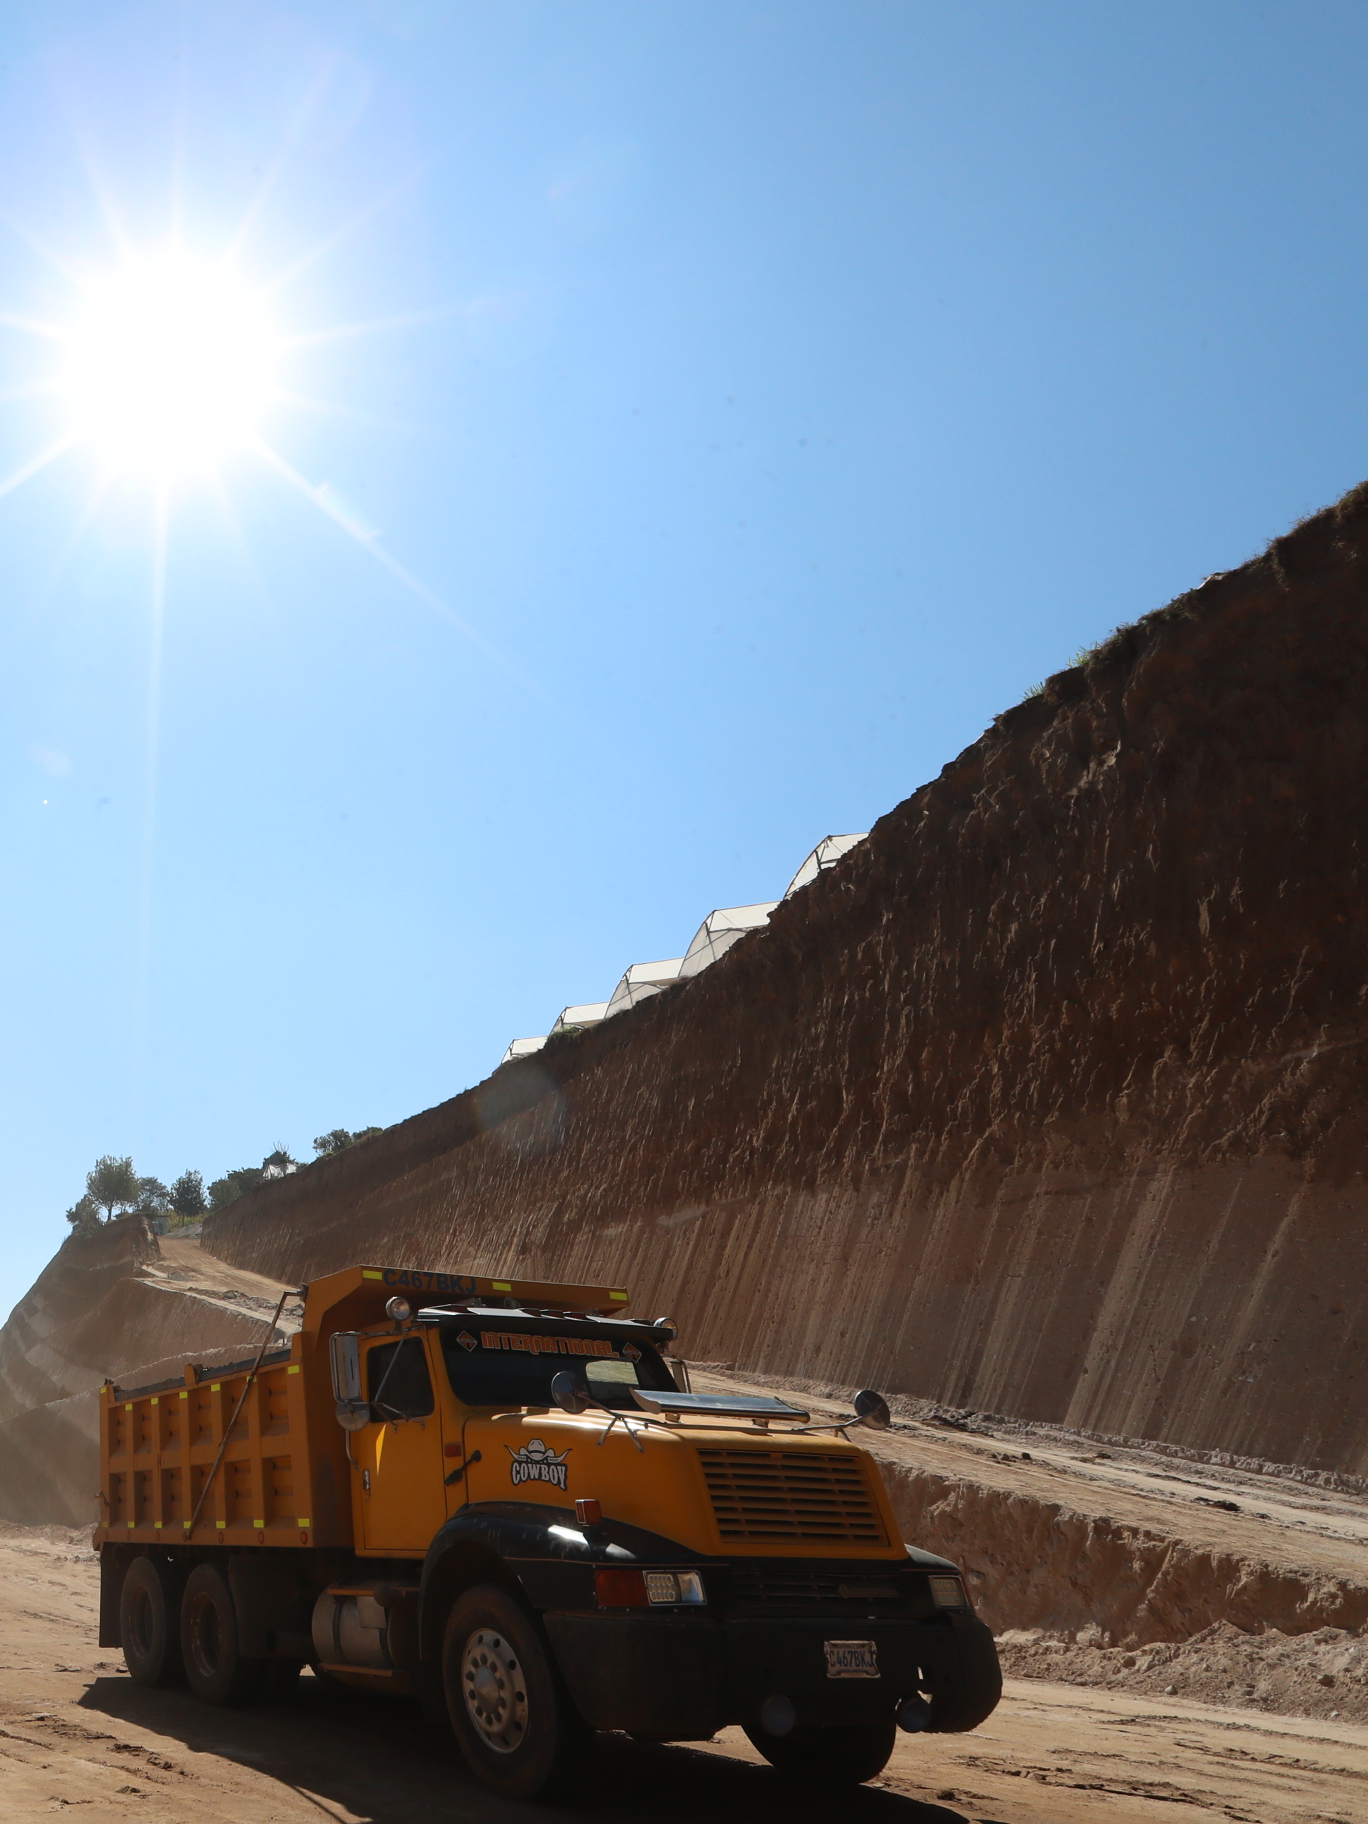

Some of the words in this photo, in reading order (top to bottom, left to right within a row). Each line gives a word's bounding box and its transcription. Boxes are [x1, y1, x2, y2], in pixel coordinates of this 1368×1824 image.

[383, 1268, 477, 1294] C467BKJ
[480, 1331, 620, 1358] INTERNATIONAL
[512, 1461, 566, 1491] COWBOY
[829, 1649, 875, 1668] C467BKJ
